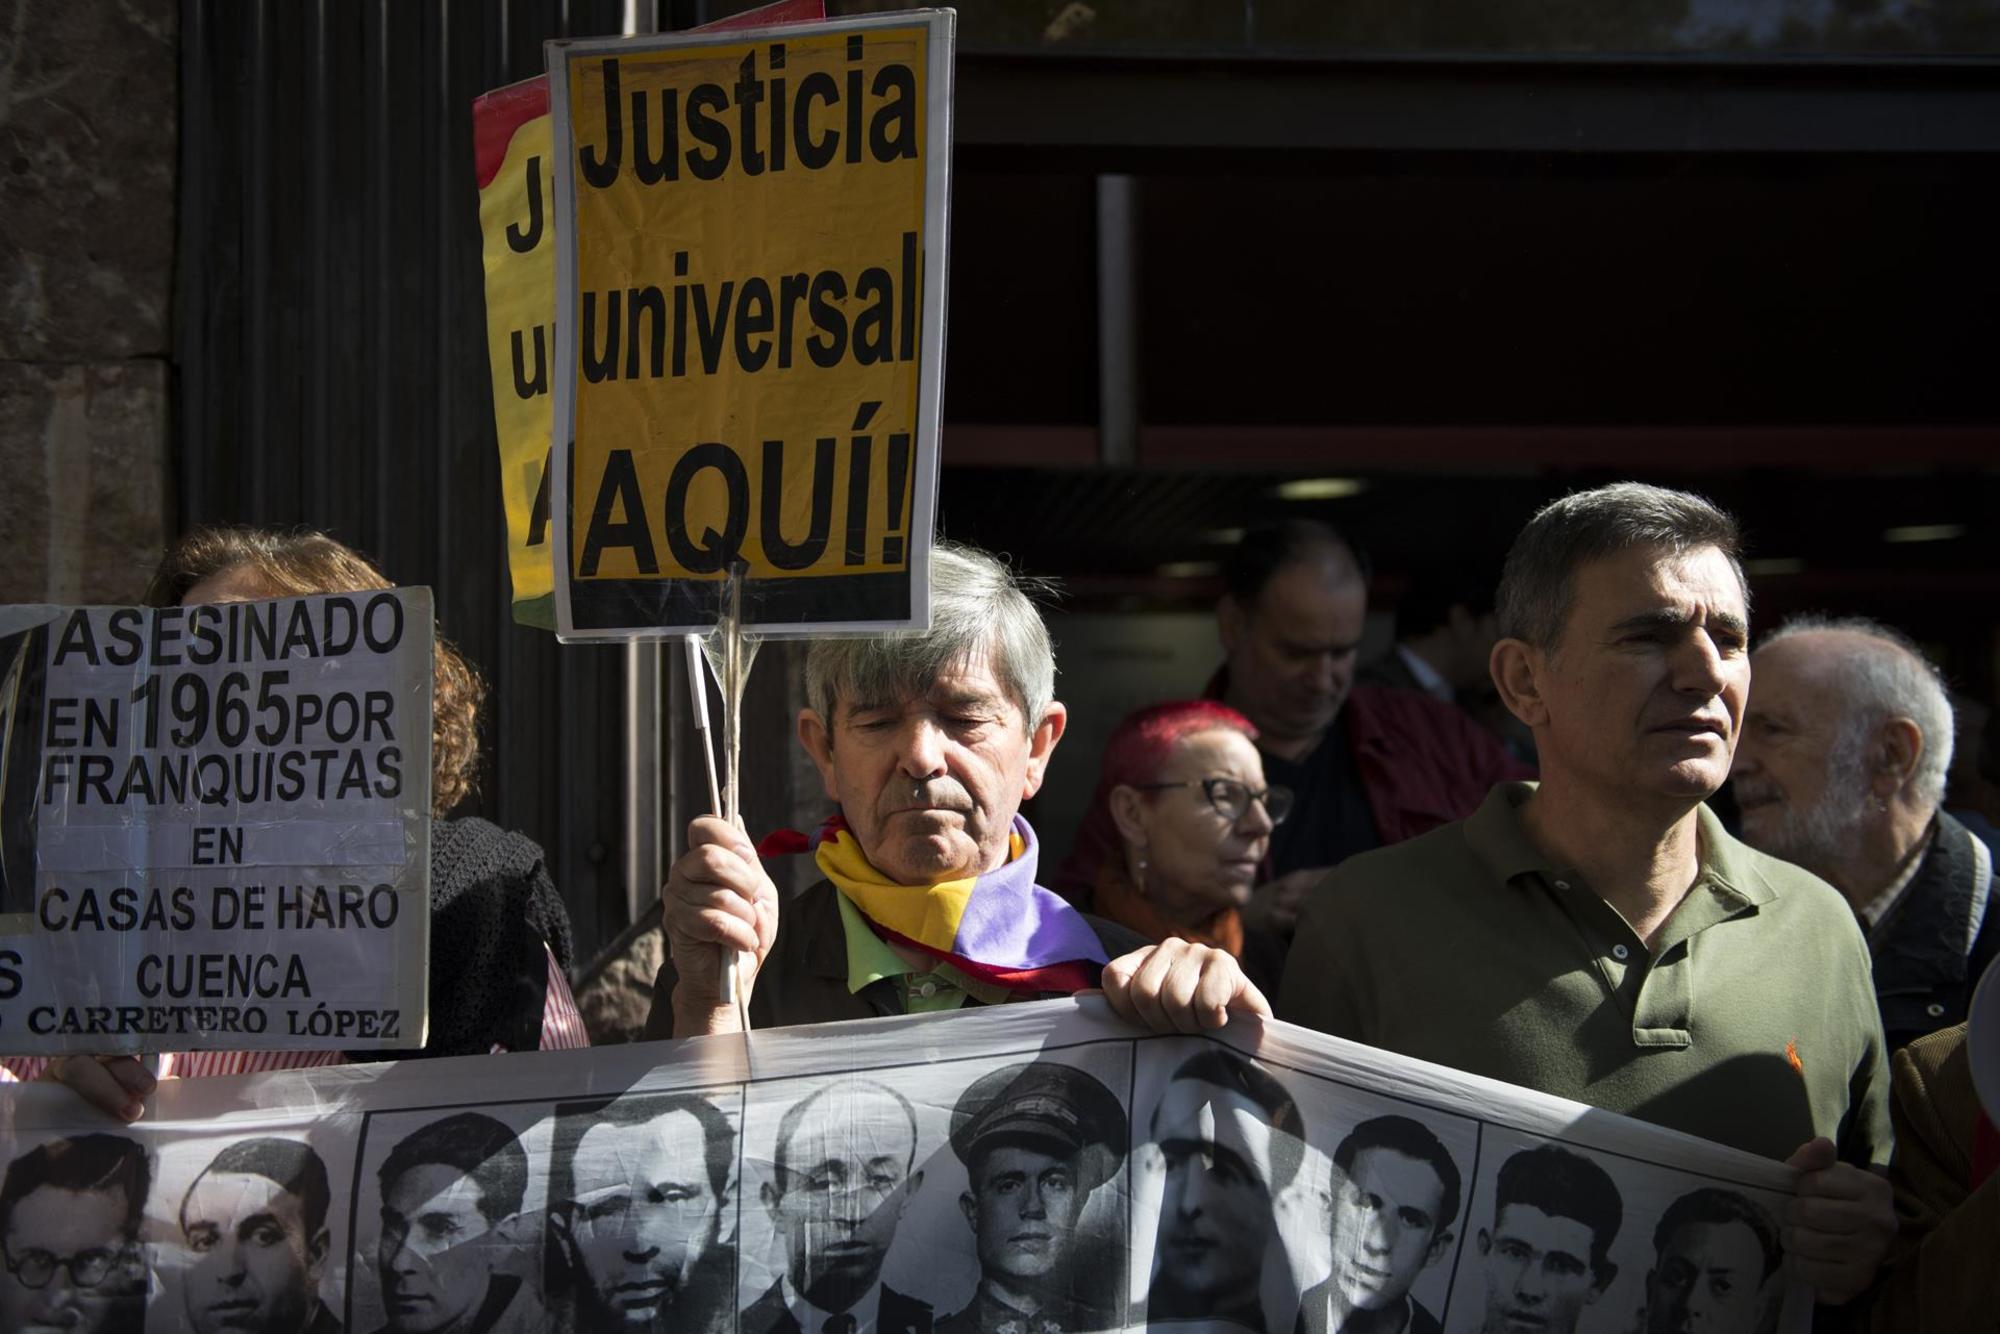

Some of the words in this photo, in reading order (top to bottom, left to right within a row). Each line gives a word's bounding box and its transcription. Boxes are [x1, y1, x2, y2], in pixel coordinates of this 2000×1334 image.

[579, 35, 919, 189] Justicia
[581, 231, 919, 385] universal
[578, 401, 911, 578] AQUÍ!
[52, 593, 404, 667] ASESINADO
[45, 698, 119, 748] EN
[131, 670, 290, 749] 1965
[295, 691, 395, 744] POR
[43, 746, 404, 806] FRANQUISTAS
[191, 827, 244, 866] EN
[38, 887, 196, 932] CASAS
[212, 887, 265, 930] DE
[277, 884, 399, 930] HARO
[136, 954, 311, 999] CUENCA
[27, 1006, 267, 1035] CARRETERO
[287, 1003, 401, 1039] LÓPEZ
